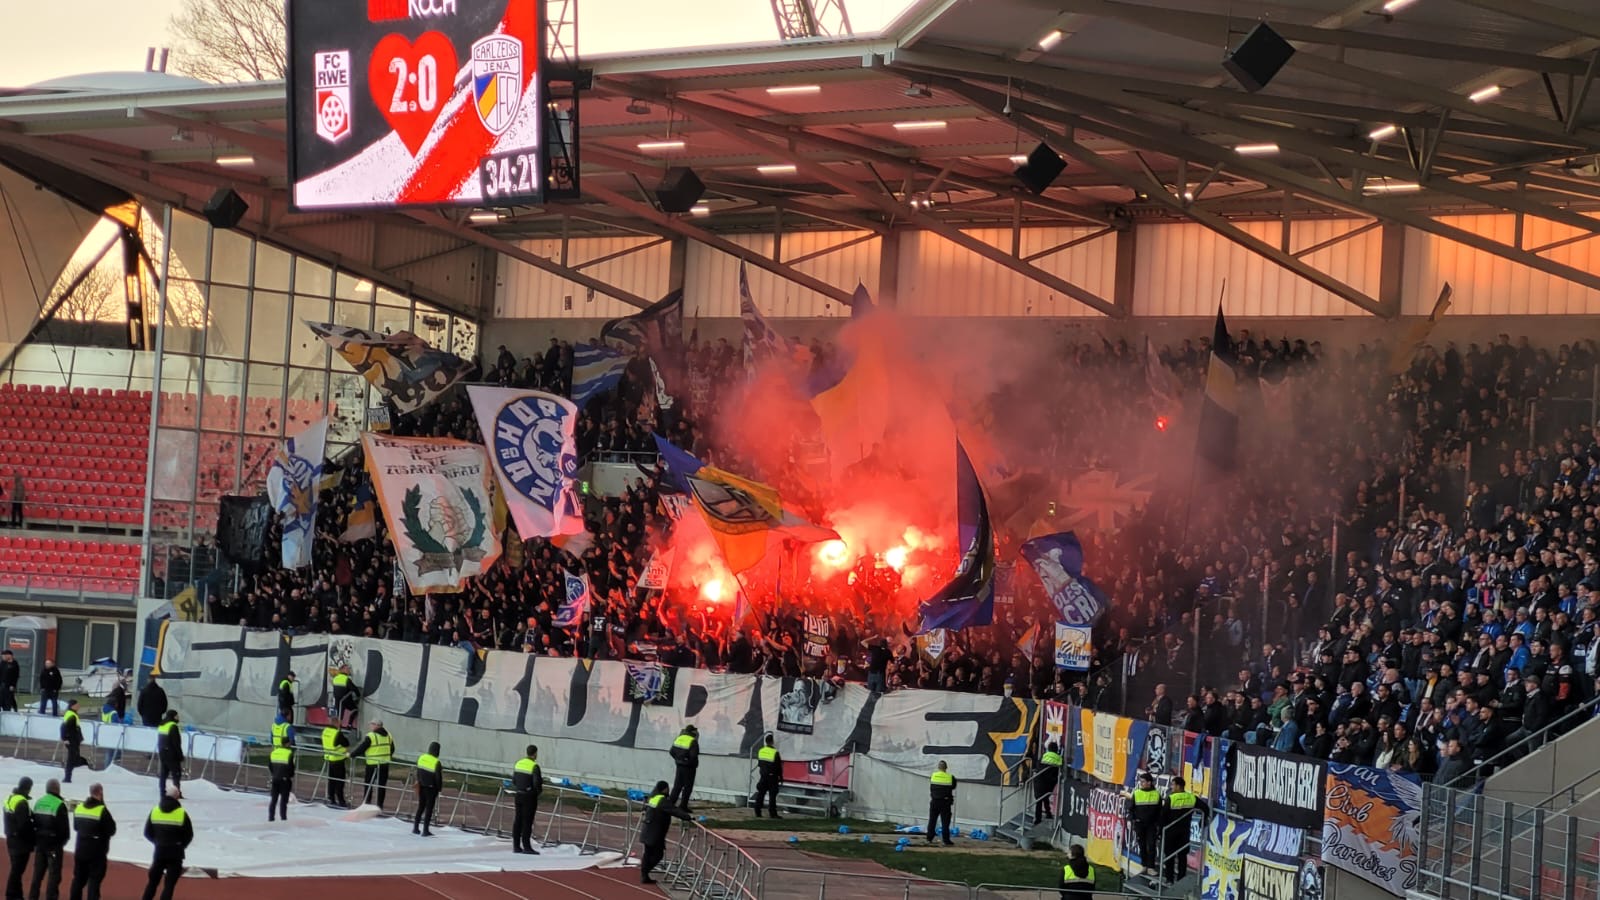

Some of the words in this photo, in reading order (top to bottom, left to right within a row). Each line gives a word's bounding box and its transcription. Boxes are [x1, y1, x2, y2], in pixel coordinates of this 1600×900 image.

[318, 70, 347, 86] RWE
[323, 54, 340, 70] FC
[482, 62, 511, 72] JENA
[389, 54, 437, 112] 2:0
[486, 153, 537, 195] 34:21
[1297, 761, 1320, 811] GERA
[1325, 783, 1374, 822] Club
[1095, 815, 1114, 839] GERA
[1321, 817, 1397, 882] Paradies
